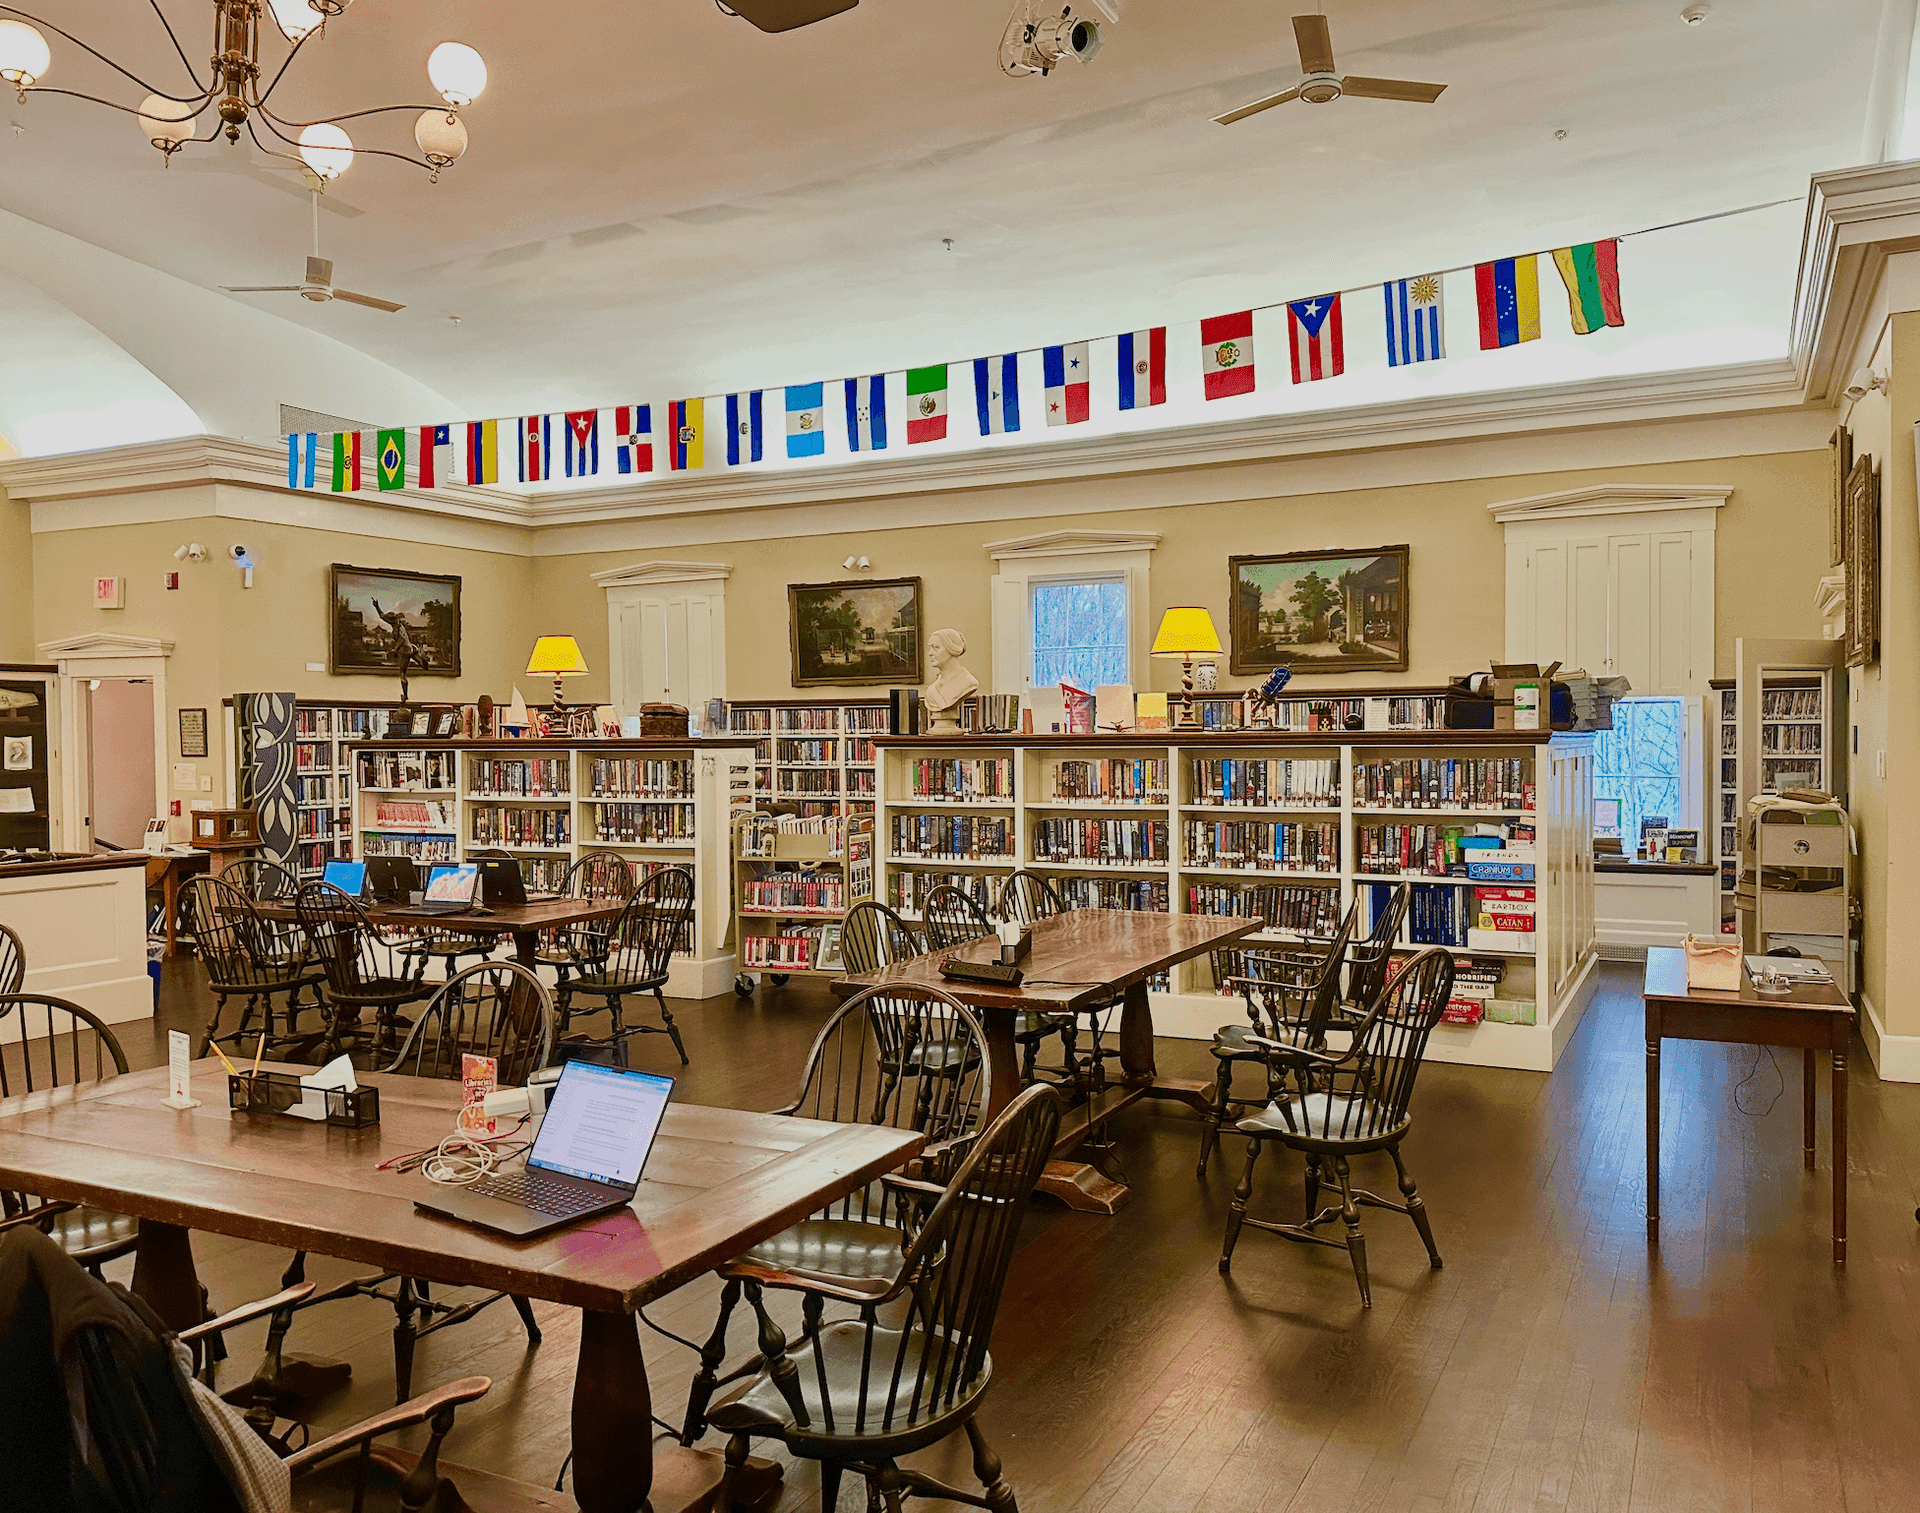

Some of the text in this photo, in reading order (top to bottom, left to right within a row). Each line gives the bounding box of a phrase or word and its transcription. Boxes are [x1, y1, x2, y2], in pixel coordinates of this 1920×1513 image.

[1481, 851, 1519, 859] FRIENDS
[1497, 917, 1524, 927] CATAN
[1455, 973, 1498, 982] HORRIFIED
[464, 1077, 492, 1088] Libraries
